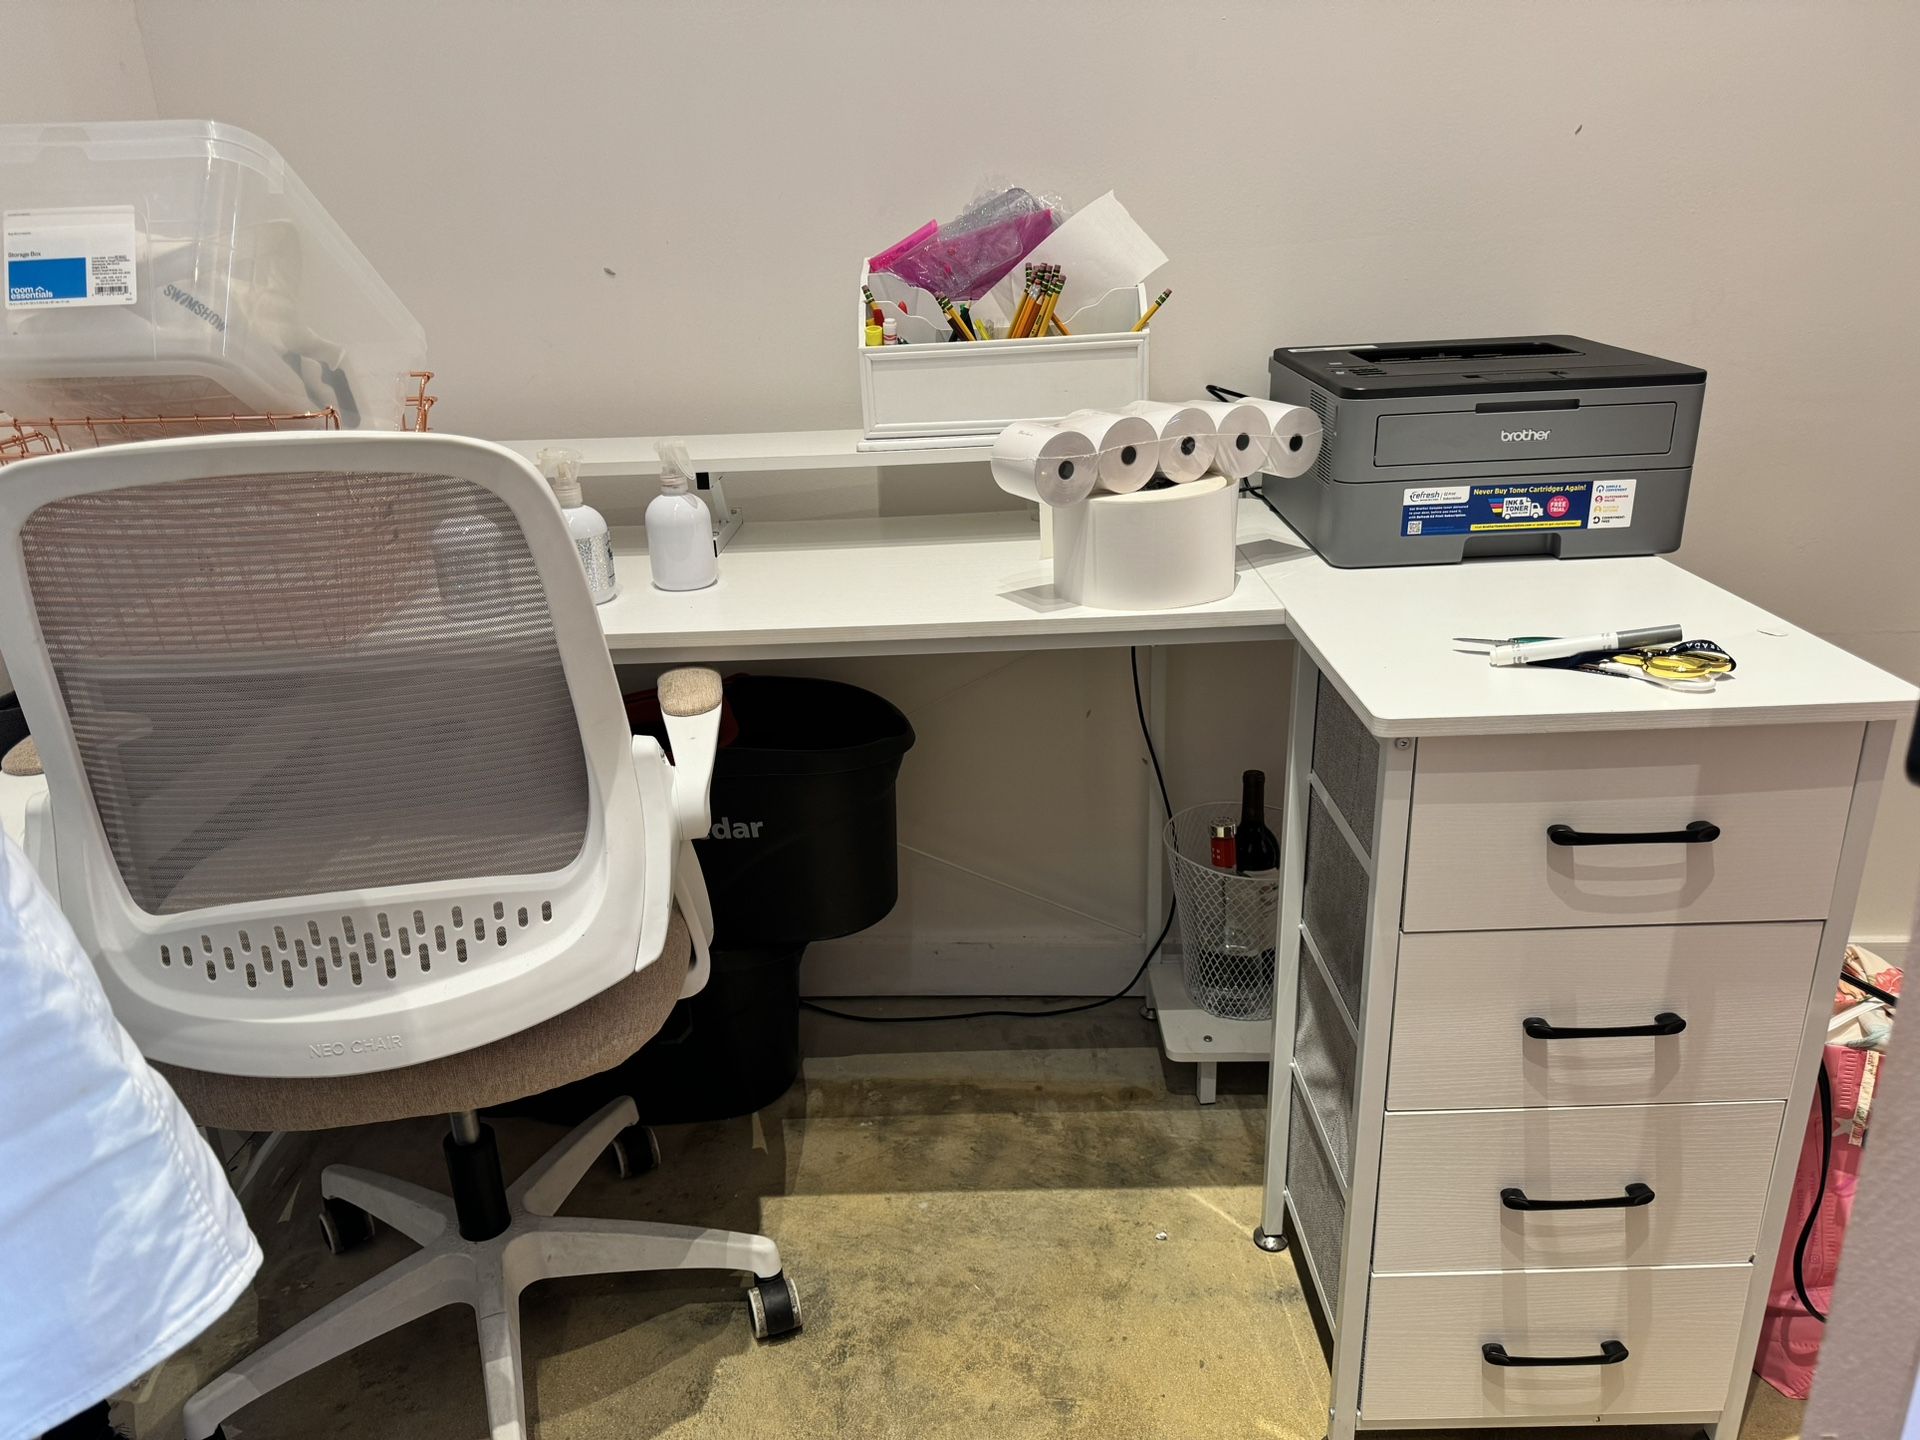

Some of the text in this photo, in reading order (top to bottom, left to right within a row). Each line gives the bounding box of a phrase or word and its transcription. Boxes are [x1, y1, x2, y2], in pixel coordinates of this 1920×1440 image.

[10, 289, 54, 300] essentials
[163, 284, 228, 333] SWIMSHOW
[1501, 429, 1551, 442] brother
[1412, 491, 1440, 500] refresh
[1494, 487, 1508, 495] Buy
[1528, 485, 1564, 494] Cartridges
[1564, 484, 1587, 492] Again!
[711, 816, 764, 839] dar
[309, 1035, 403, 1058] NEO CHAIR
